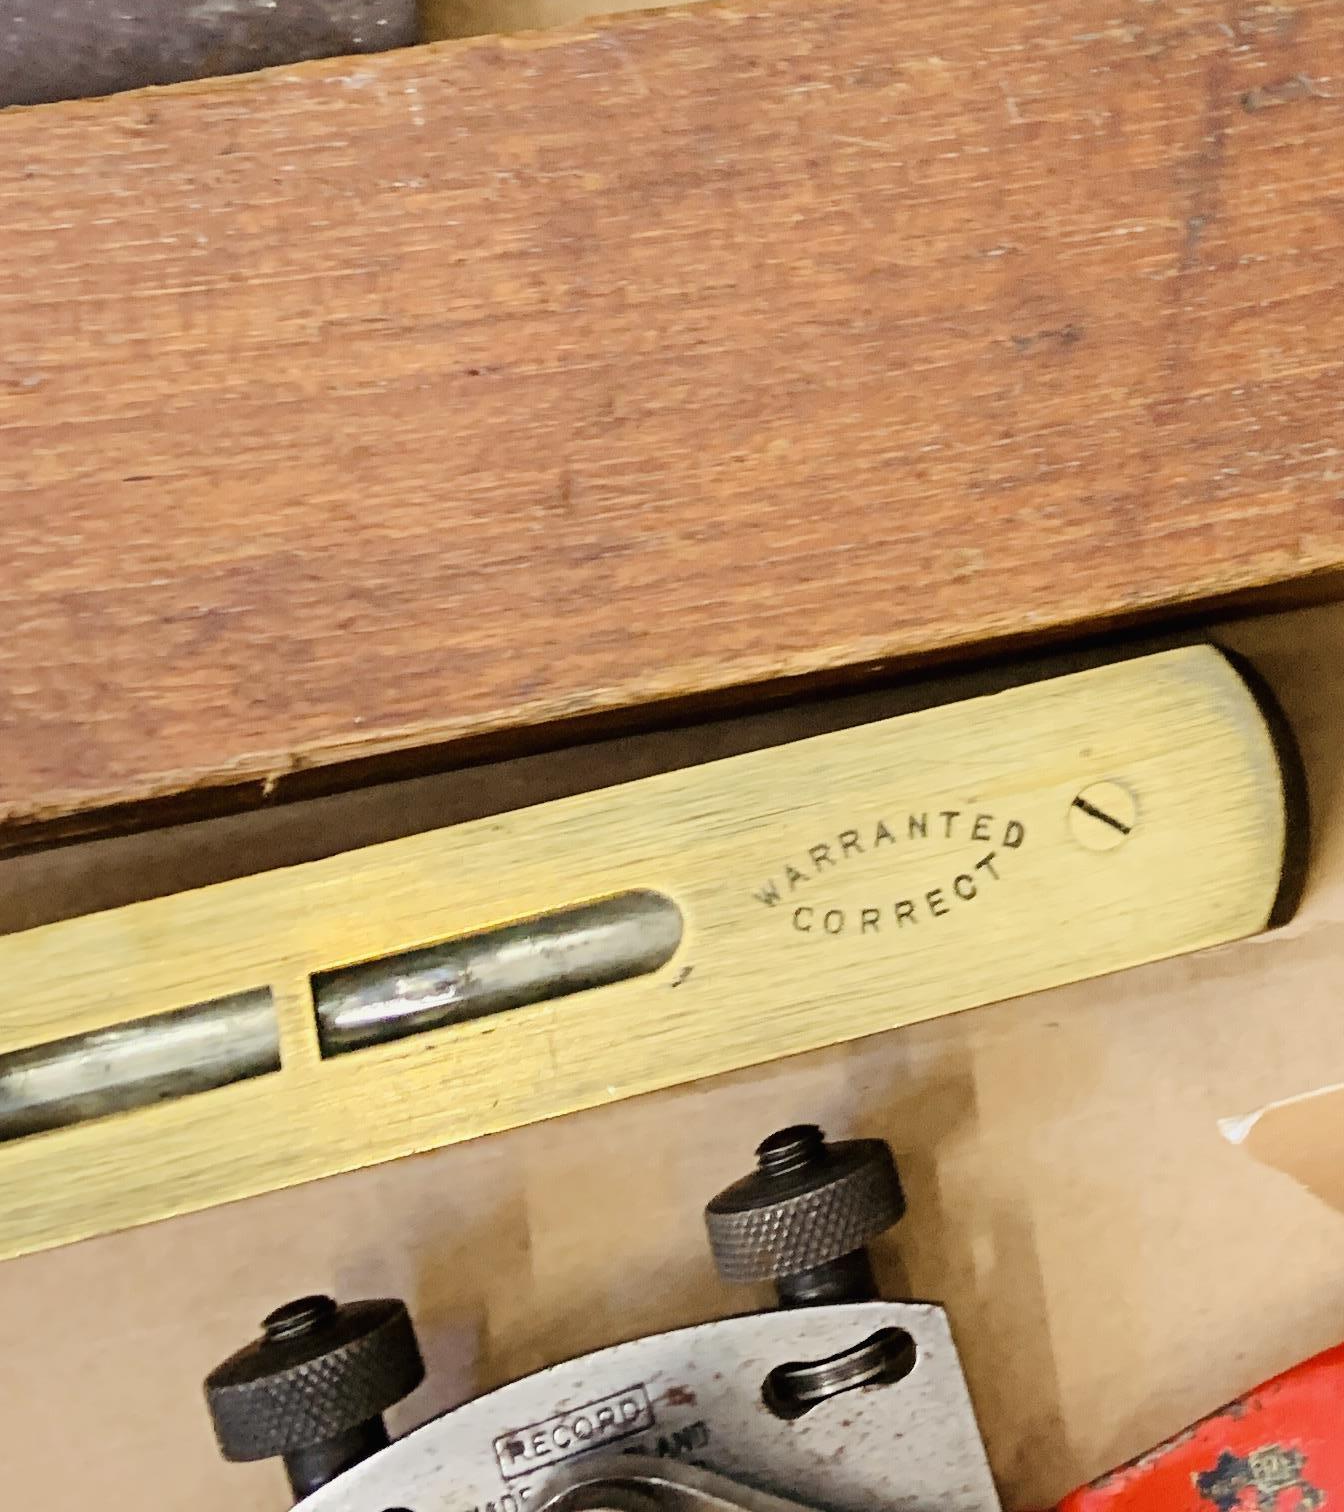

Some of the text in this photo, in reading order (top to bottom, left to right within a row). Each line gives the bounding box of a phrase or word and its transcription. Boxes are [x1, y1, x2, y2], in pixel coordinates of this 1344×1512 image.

[752, 809, 1026, 908] WARRANTED
[792, 850, 1002, 936] CORRECT
[502, 1396, 642, 1465] RECORD
